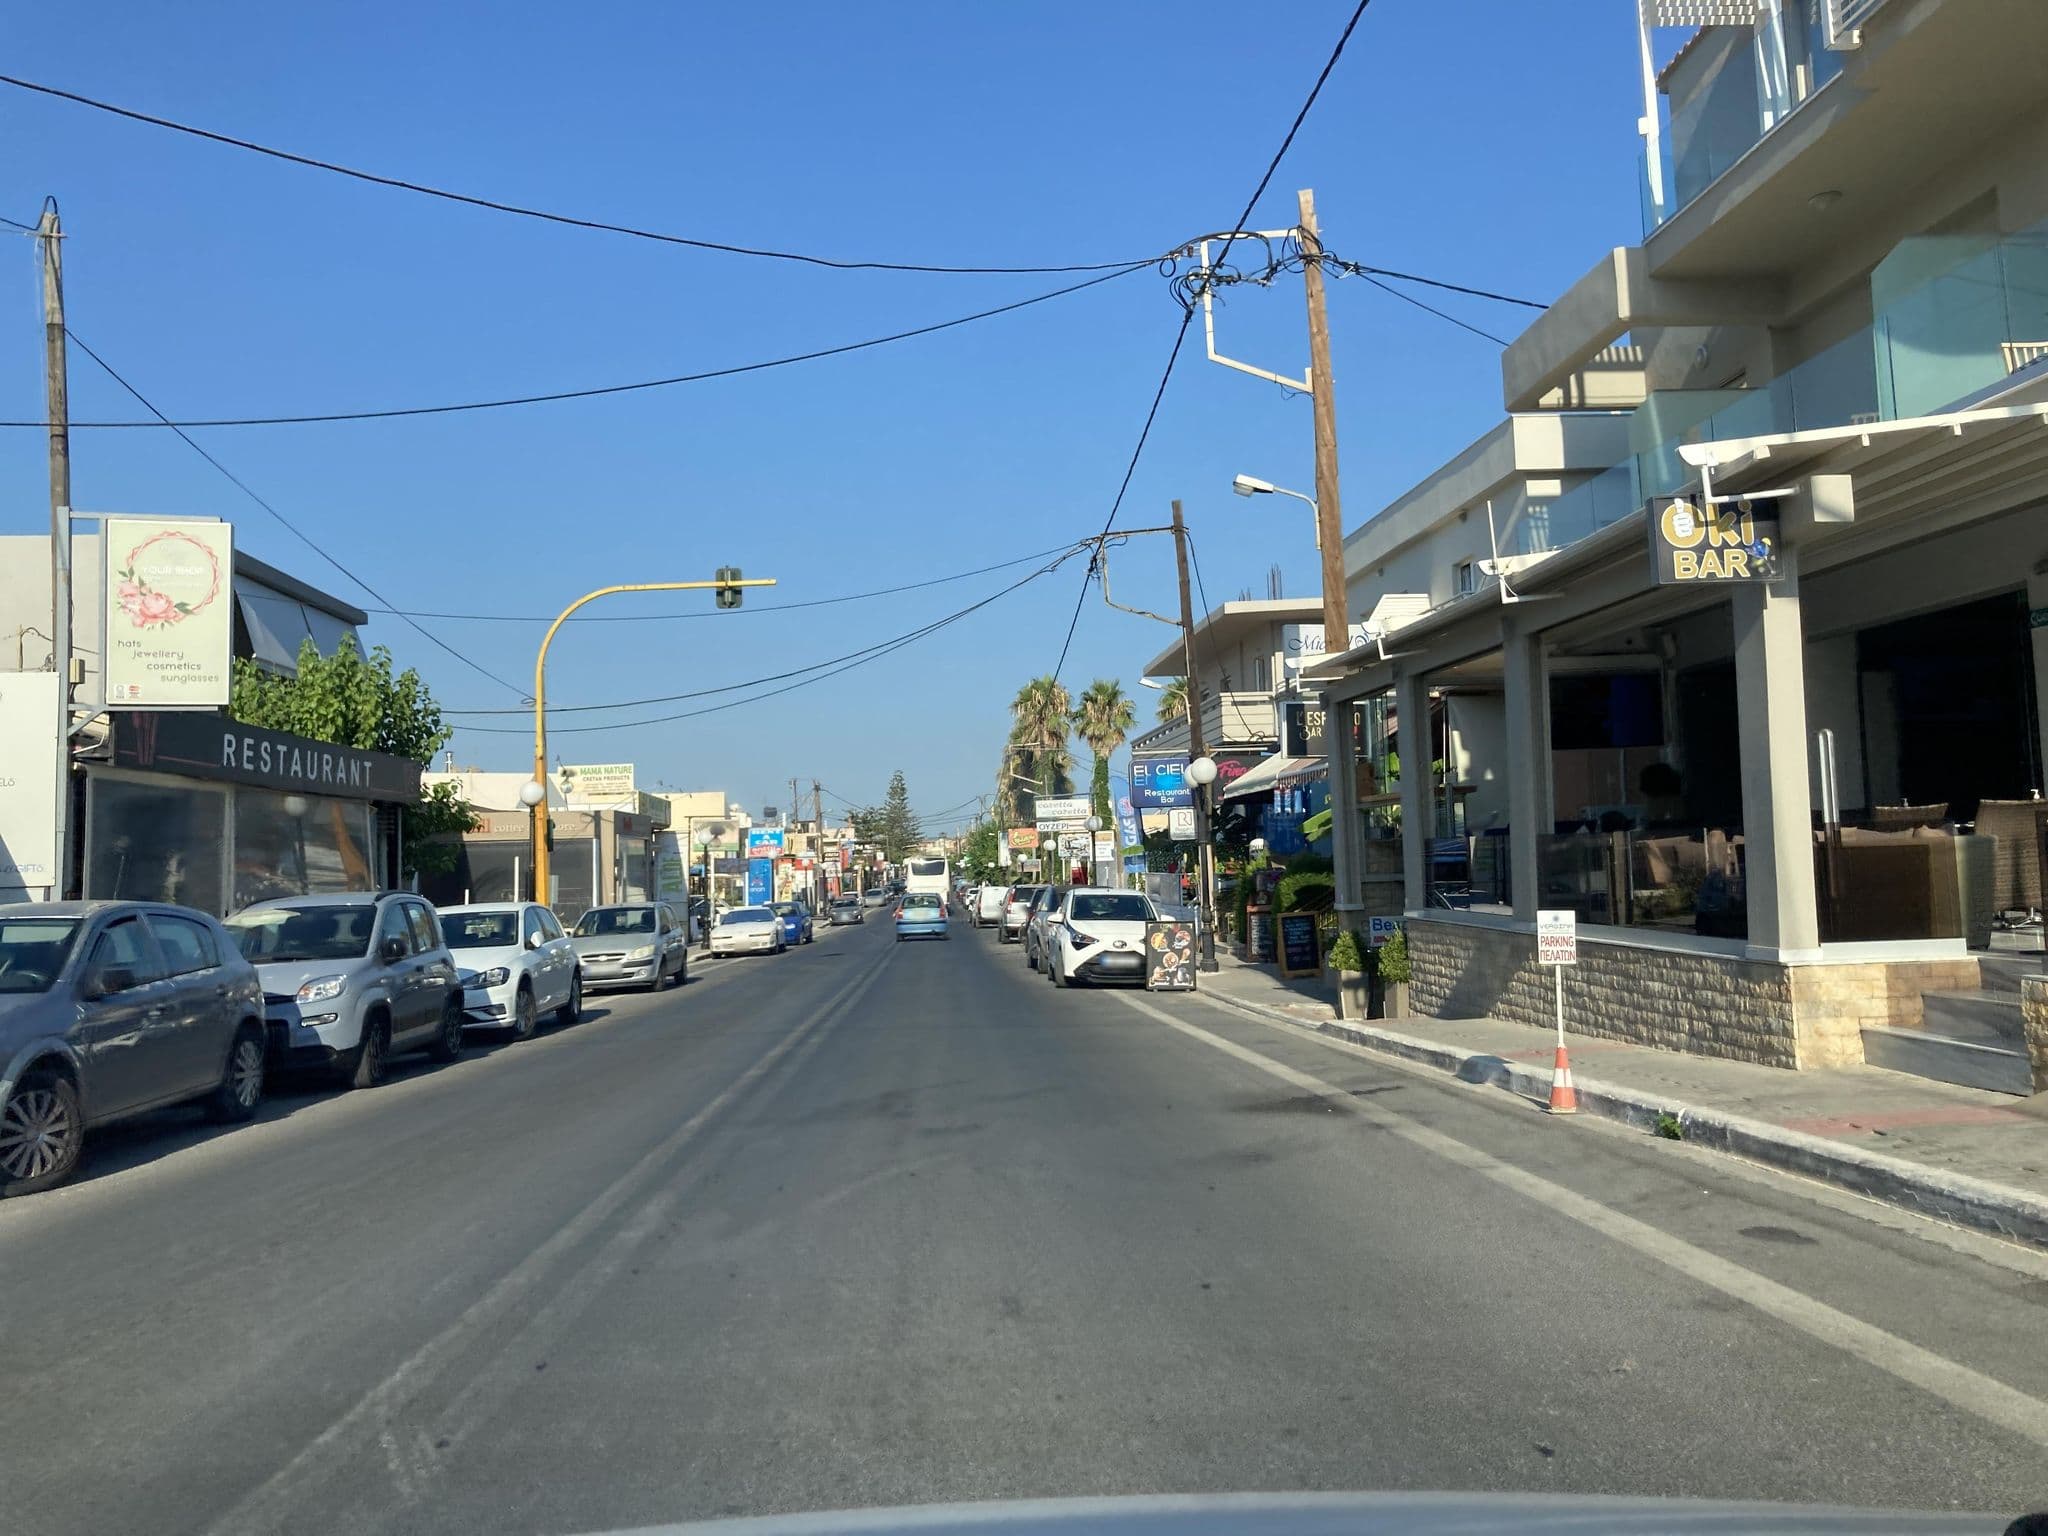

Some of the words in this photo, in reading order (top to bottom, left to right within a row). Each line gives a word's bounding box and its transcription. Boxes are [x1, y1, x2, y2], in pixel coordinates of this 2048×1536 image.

[1673, 548, 1751, 579] BAR
[117, 639, 142, 648] hats
[132, 650, 184, 660] jewellery
[146, 661, 201, 670] cosmetics
[160, 673, 219, 684] sunglasses
[223, 733, 372, 788] RESTAURANT
[604, 765, 632, 775] NATURE
[1133, 765, 1151, 777] EL
[1144, 788, 1191, 797] Restaurant
[1540, 936, 1574, 948] PARKING
